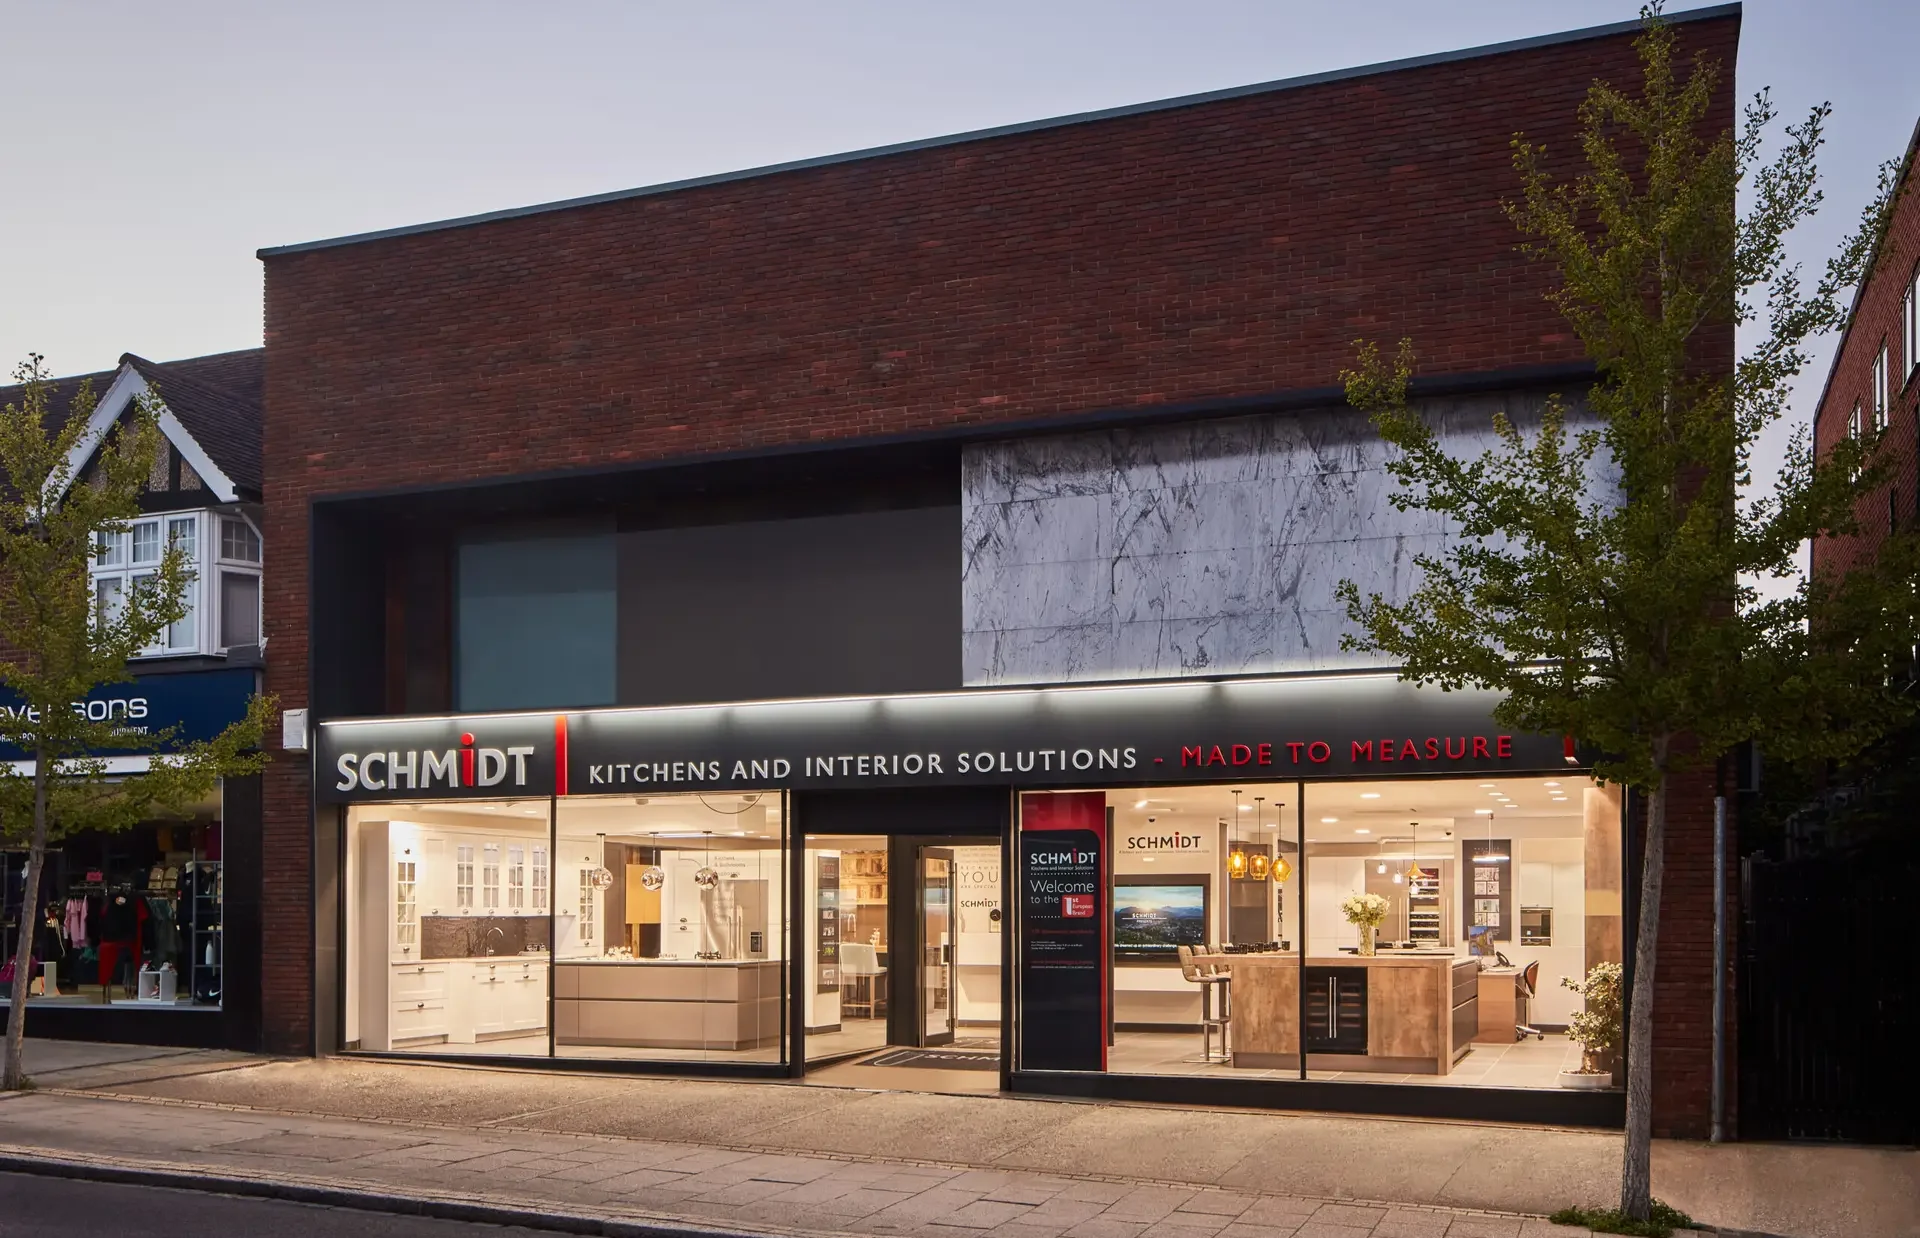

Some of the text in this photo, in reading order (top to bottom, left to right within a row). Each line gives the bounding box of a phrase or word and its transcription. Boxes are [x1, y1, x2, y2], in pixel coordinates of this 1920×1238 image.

[588, 760, 721, 784] KITCHENS
[731, 758, 791, 780] AND
[805, 754, 944, 777] INTERIOR
[957, 747, 1137, 773] SOLUTIONS
[1181, 743, 1272, 767] MADE
[1285, 741, 1332, 763] TO
[1351, 735, 1513, 763] MEASURE
[961, 871, 999, 883] YOU
[1030, 879, 1095, 893] Welcome
[1030, 896, 1041, 904] to
[1044, 895, 1060, 904] the
